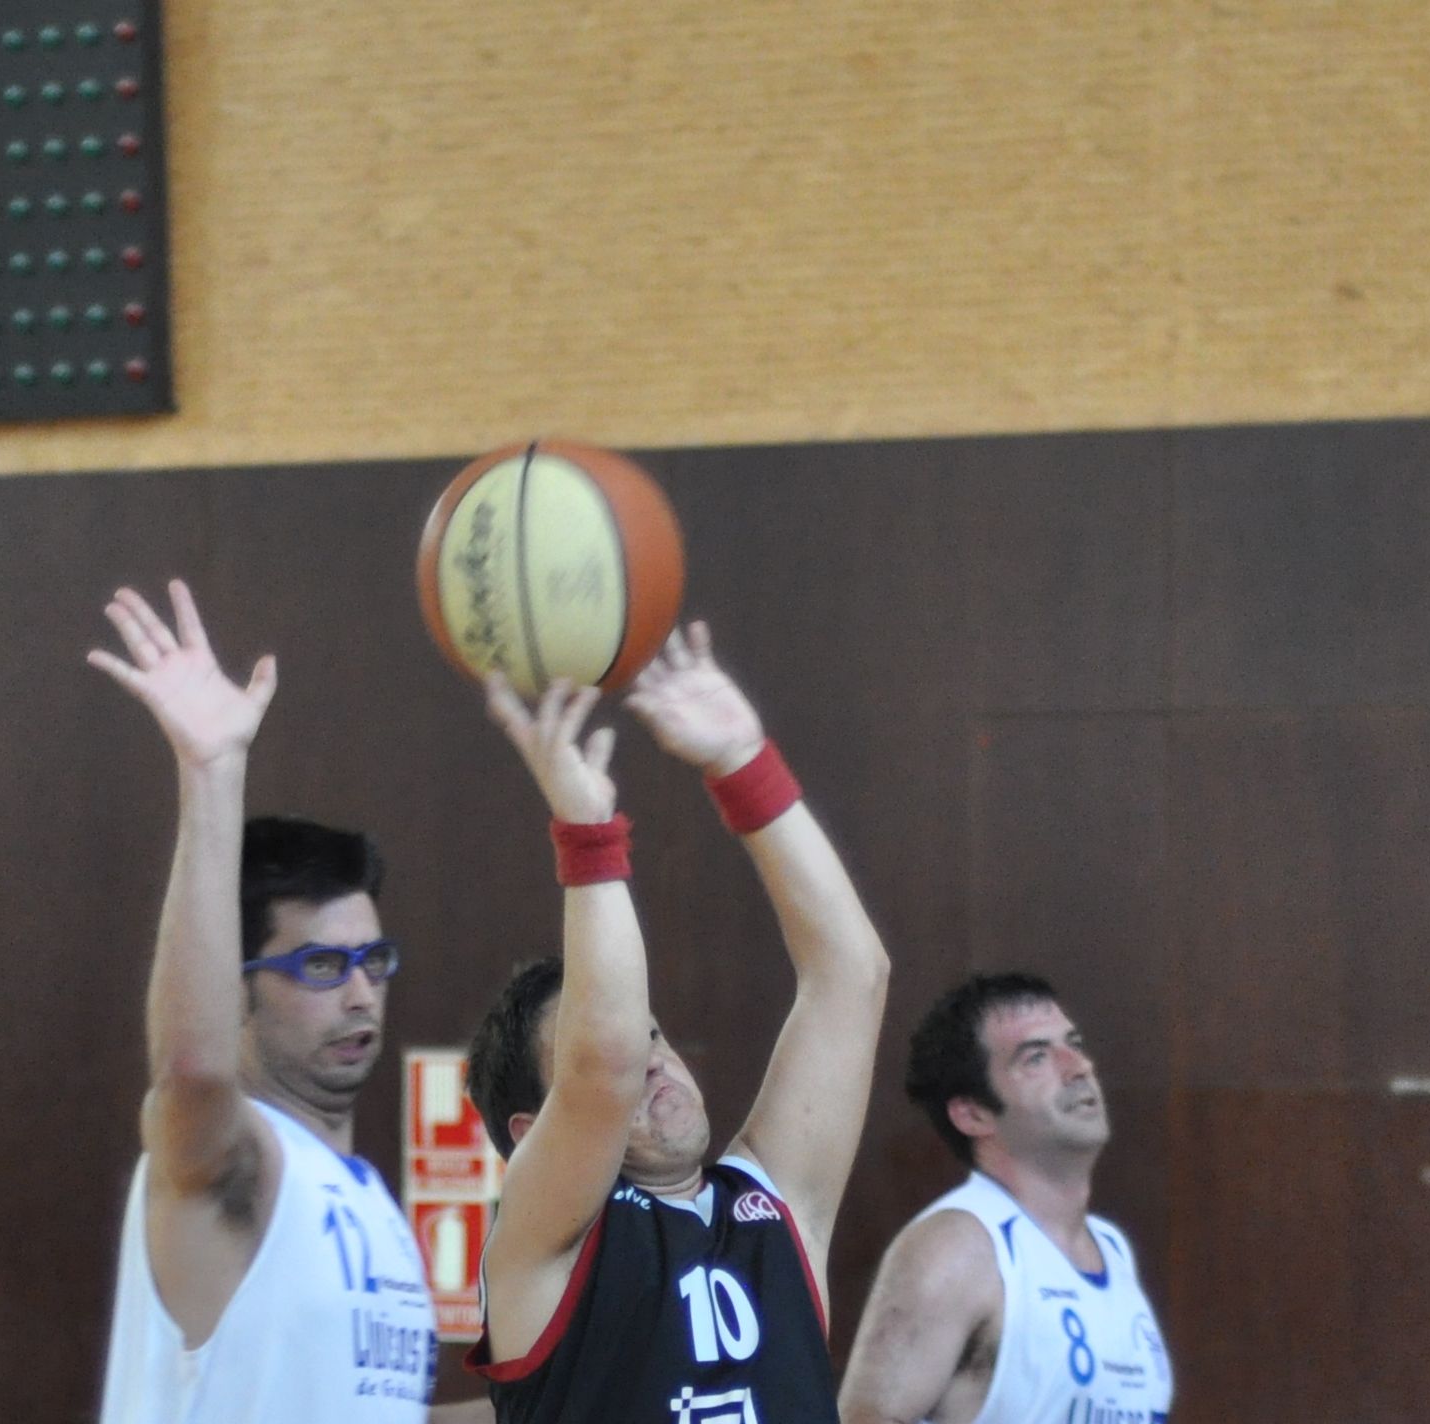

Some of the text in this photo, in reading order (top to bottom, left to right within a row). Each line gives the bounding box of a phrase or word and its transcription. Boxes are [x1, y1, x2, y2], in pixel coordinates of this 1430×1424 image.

[322, 1202, 379, 1293] 12
[679, 1265, 760, 1362] 10
[1062, 1307, 1095, 1387] 8
